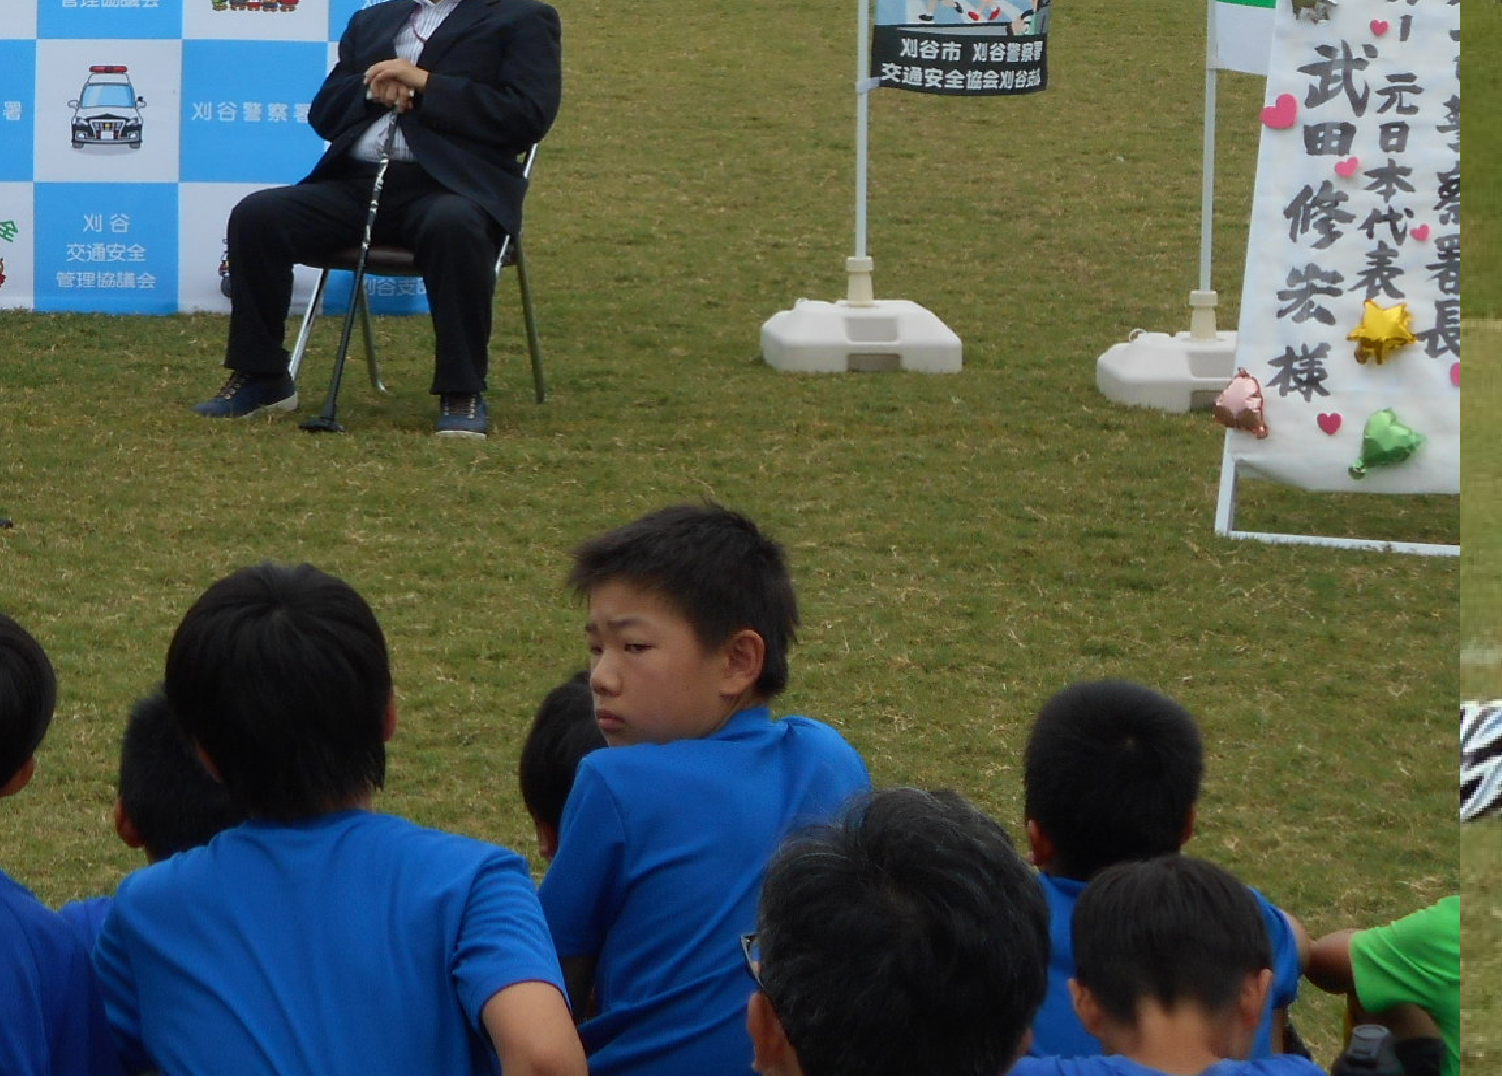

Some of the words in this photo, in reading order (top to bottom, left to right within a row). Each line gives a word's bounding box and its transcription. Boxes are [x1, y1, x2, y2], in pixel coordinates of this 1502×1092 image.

[900, 38, 962, 61] 刈谷市
[972, 40, 1043, 63] 刈谷警察署
[191, 102, 311, 123] 刈谷警察署
[1353, 72, 1424, 299] 元日本代表
[83, 214, 130, 232] 刈谷
[67, 244, 146, 262] 交通安全
[57, 271, 157, 288] 管理協議会
